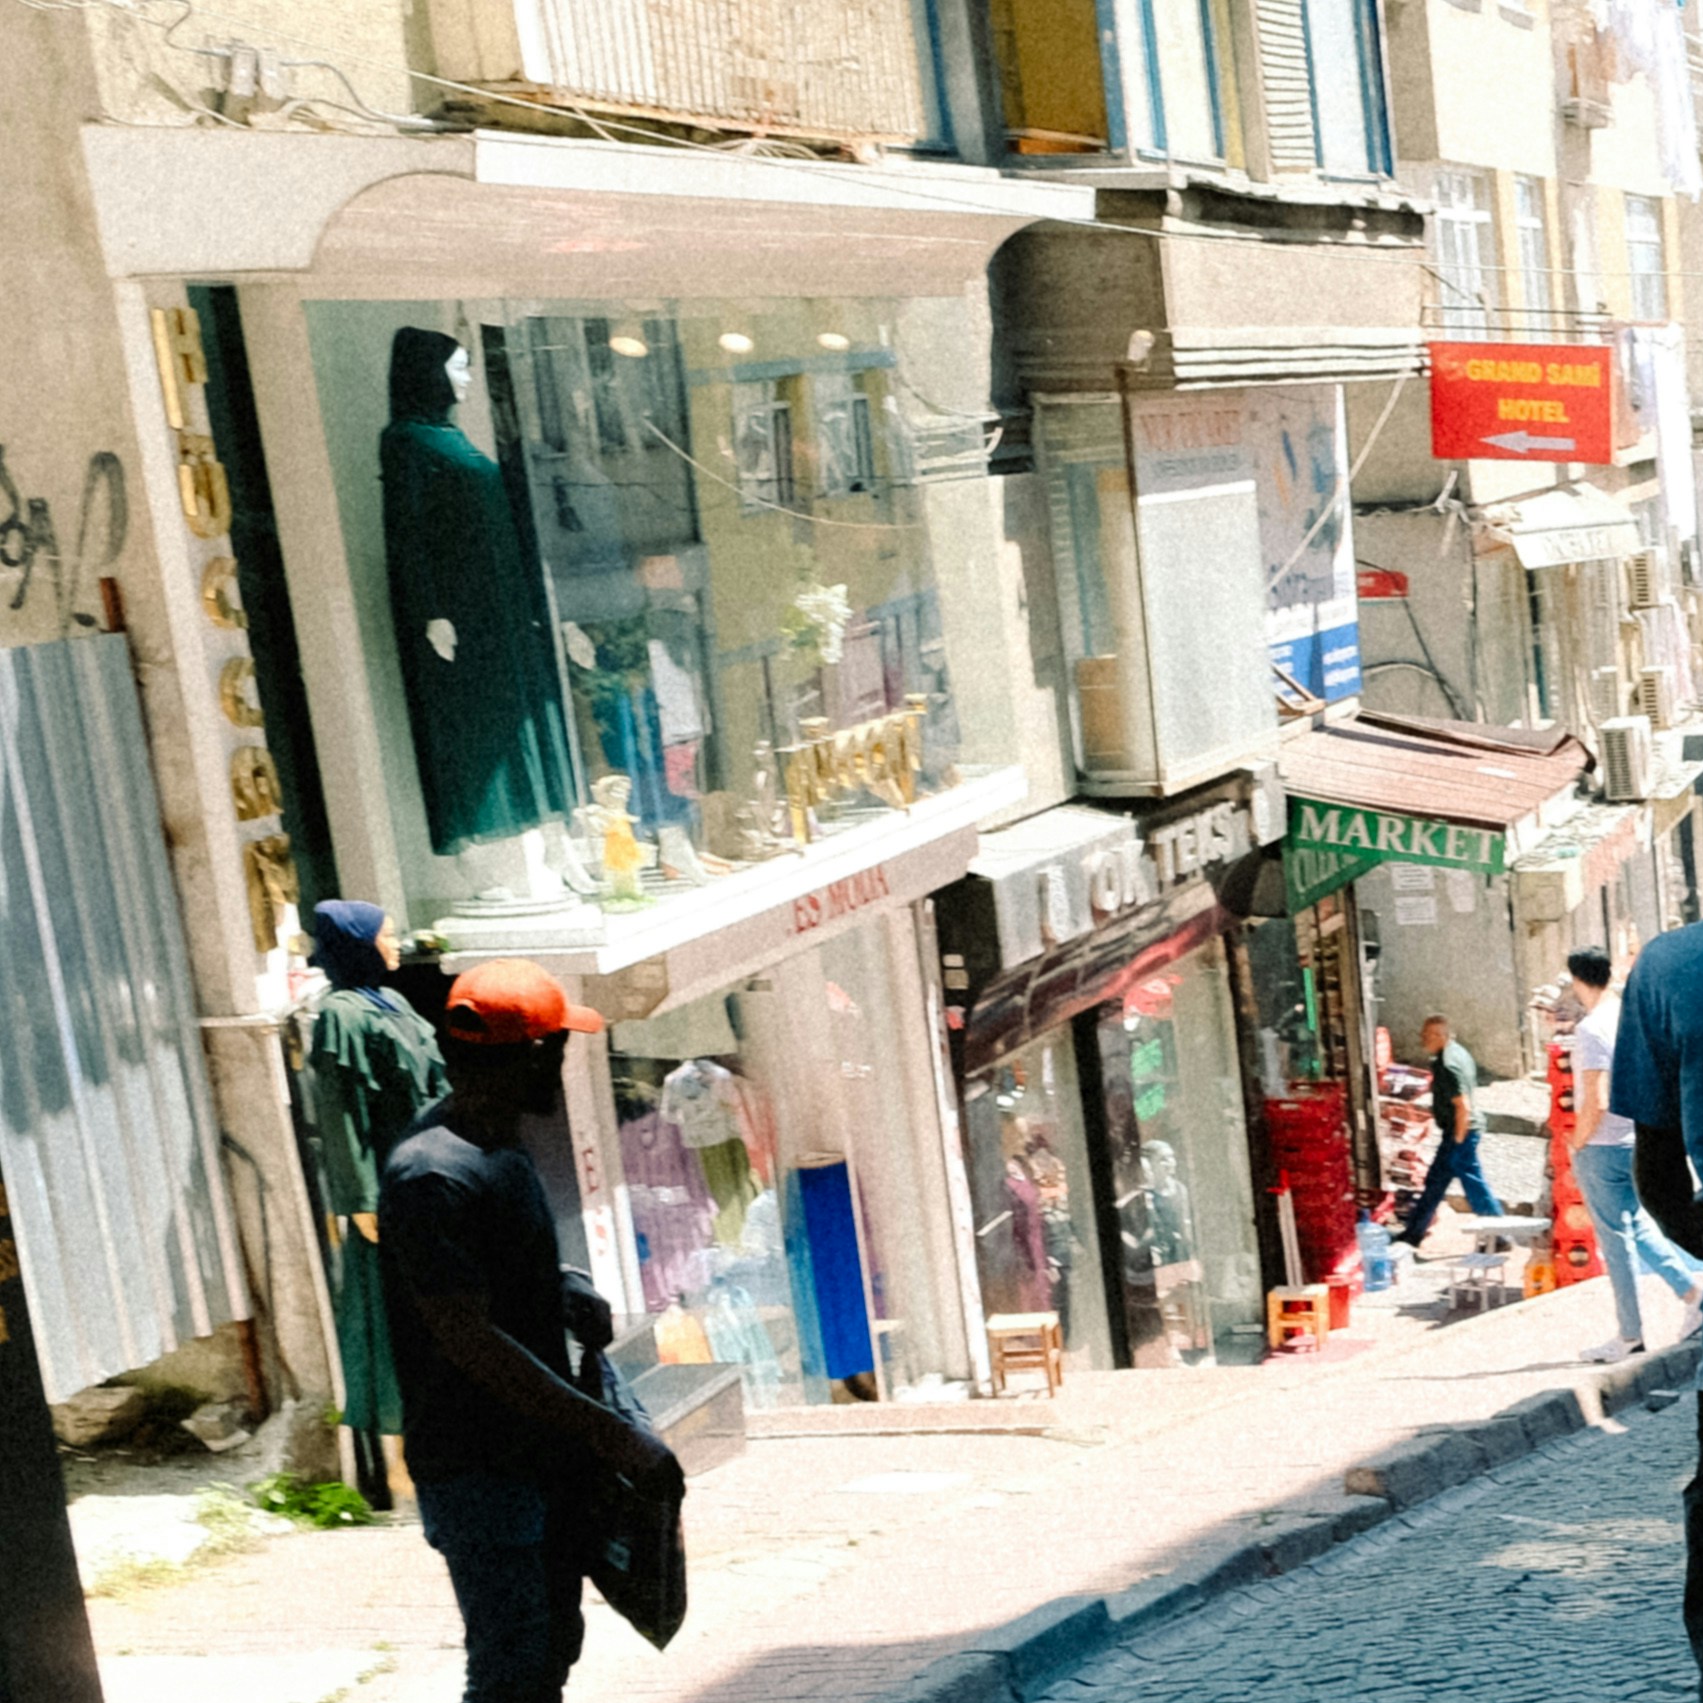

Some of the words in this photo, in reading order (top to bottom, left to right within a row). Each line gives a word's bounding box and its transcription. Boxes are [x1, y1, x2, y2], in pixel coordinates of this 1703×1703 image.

[1466, 359, 1543, 384] GRAND
[1497, 397, 1571, 424] HOTEL
[1299, 805, 1503, 865] MARKET
